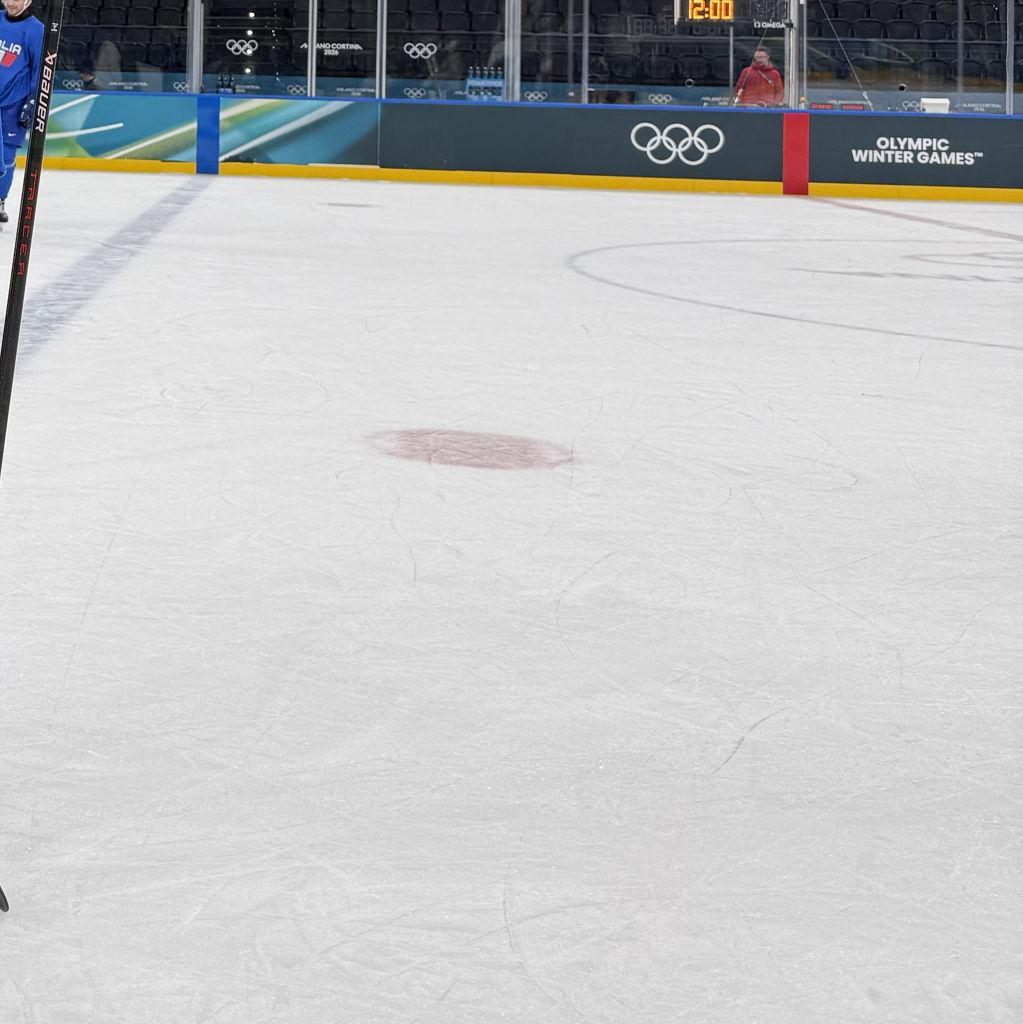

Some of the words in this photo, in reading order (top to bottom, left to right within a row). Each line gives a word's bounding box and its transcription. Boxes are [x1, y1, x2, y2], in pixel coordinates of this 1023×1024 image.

[689, 0, 733, 20] 12:00
[761, 21, 786, 29] OMEGA
[300, 42, 330, 50] MANO
[332, 42, 362, 51] CORTINA
[876, 136, 950, 151] OLYMPIC
[852, 149, 914, 164] WINTER
